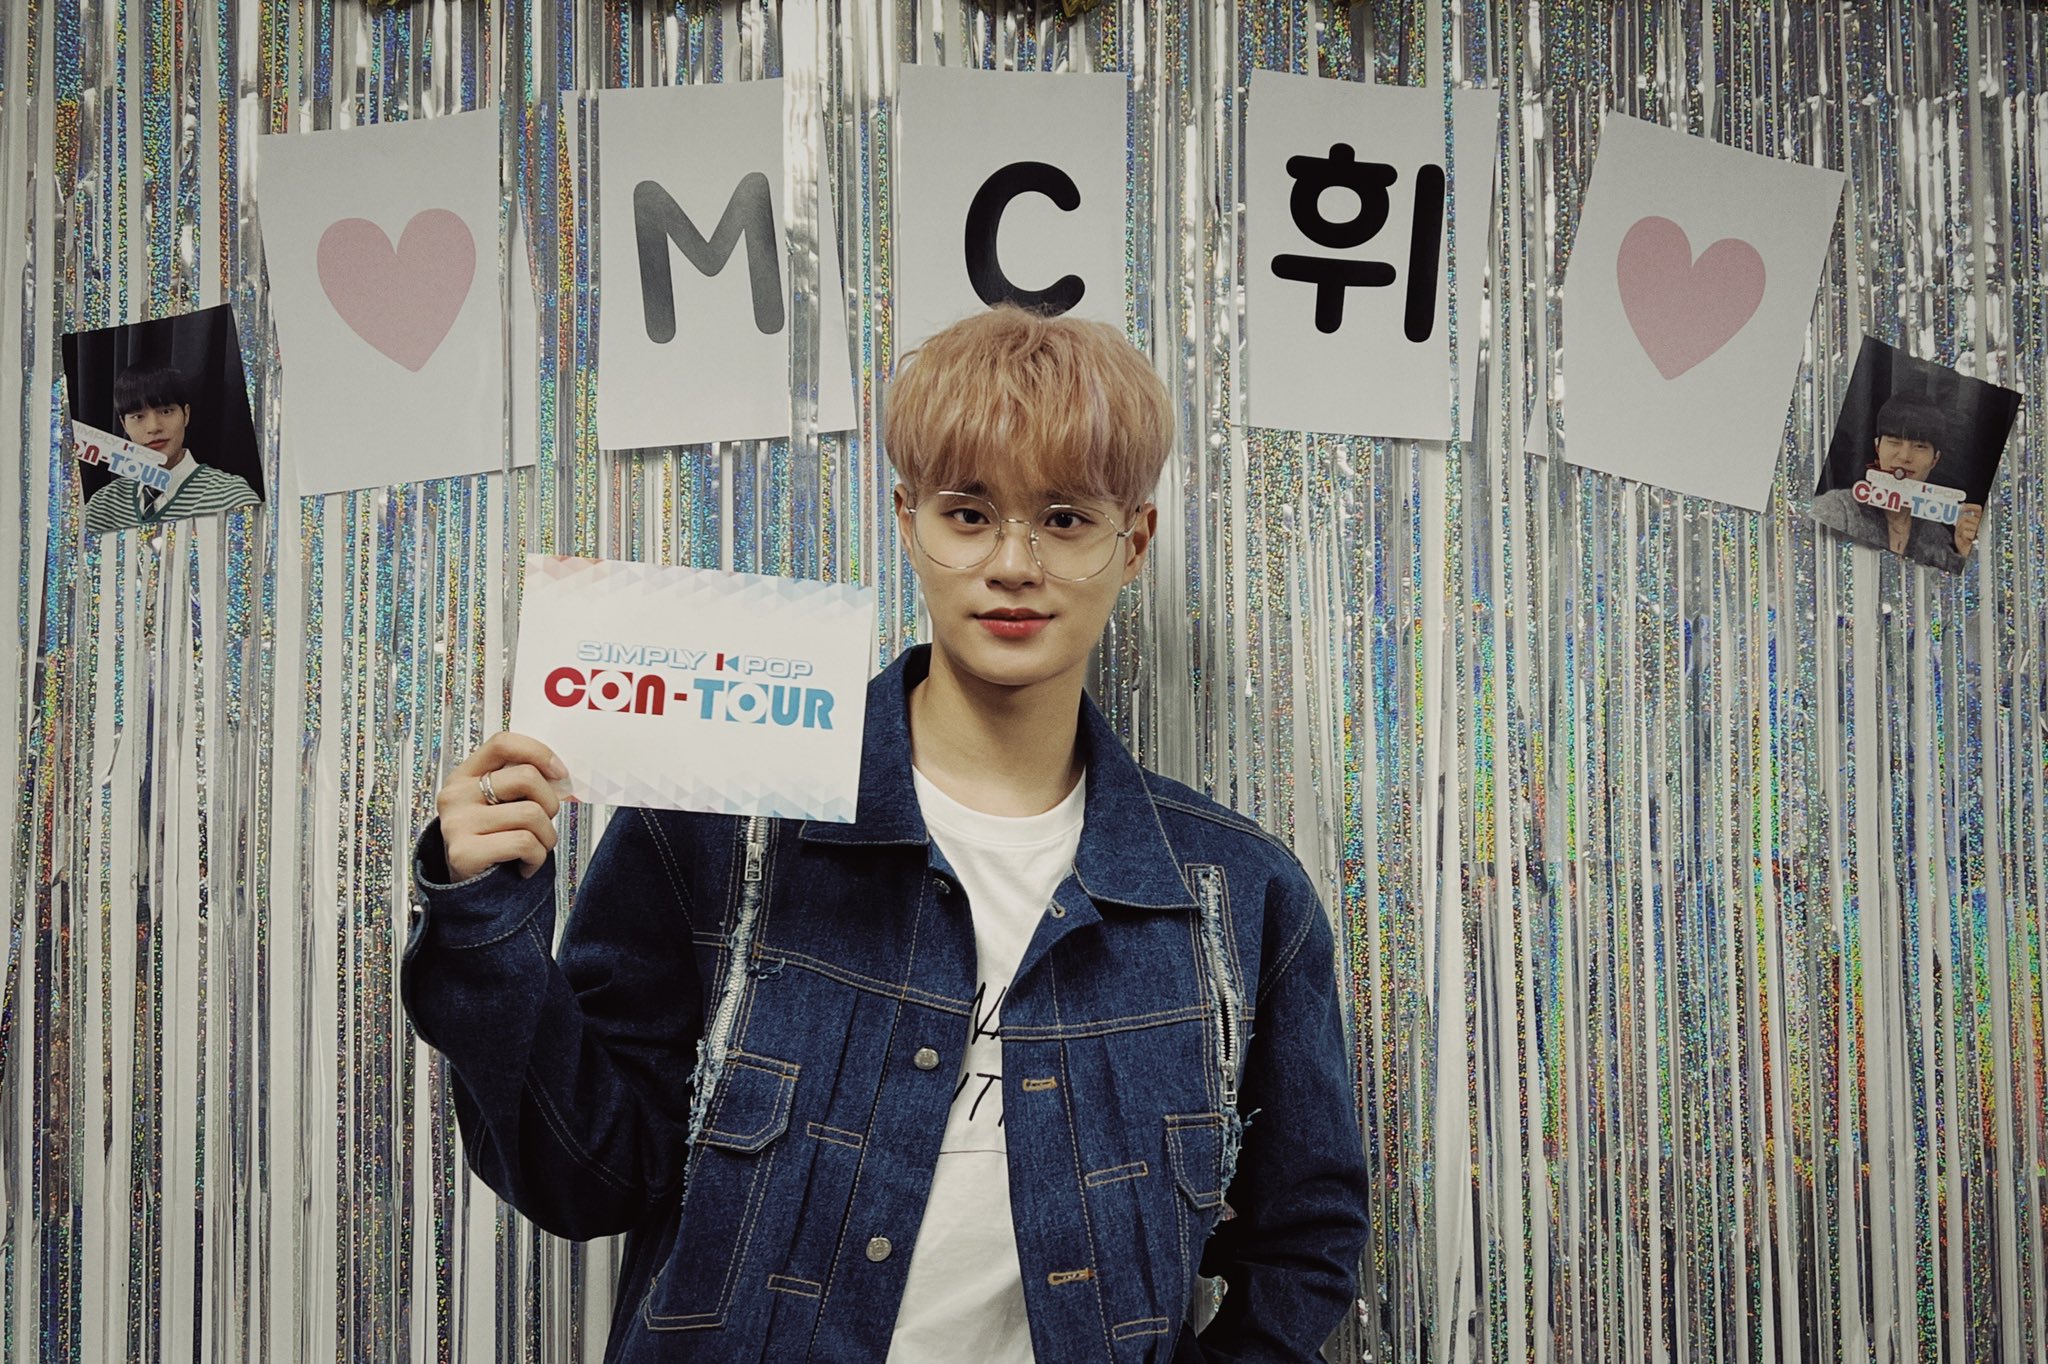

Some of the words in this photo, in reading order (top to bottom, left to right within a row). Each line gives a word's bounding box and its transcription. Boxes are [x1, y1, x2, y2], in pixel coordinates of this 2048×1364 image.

[1270, 142, 1446, 344] 휘
[1855, 483, 1961, 523] CON-TOU
[577, 640, 707, 670] SIMPLY
[544, 666, 835, 730] CON-TOUR
